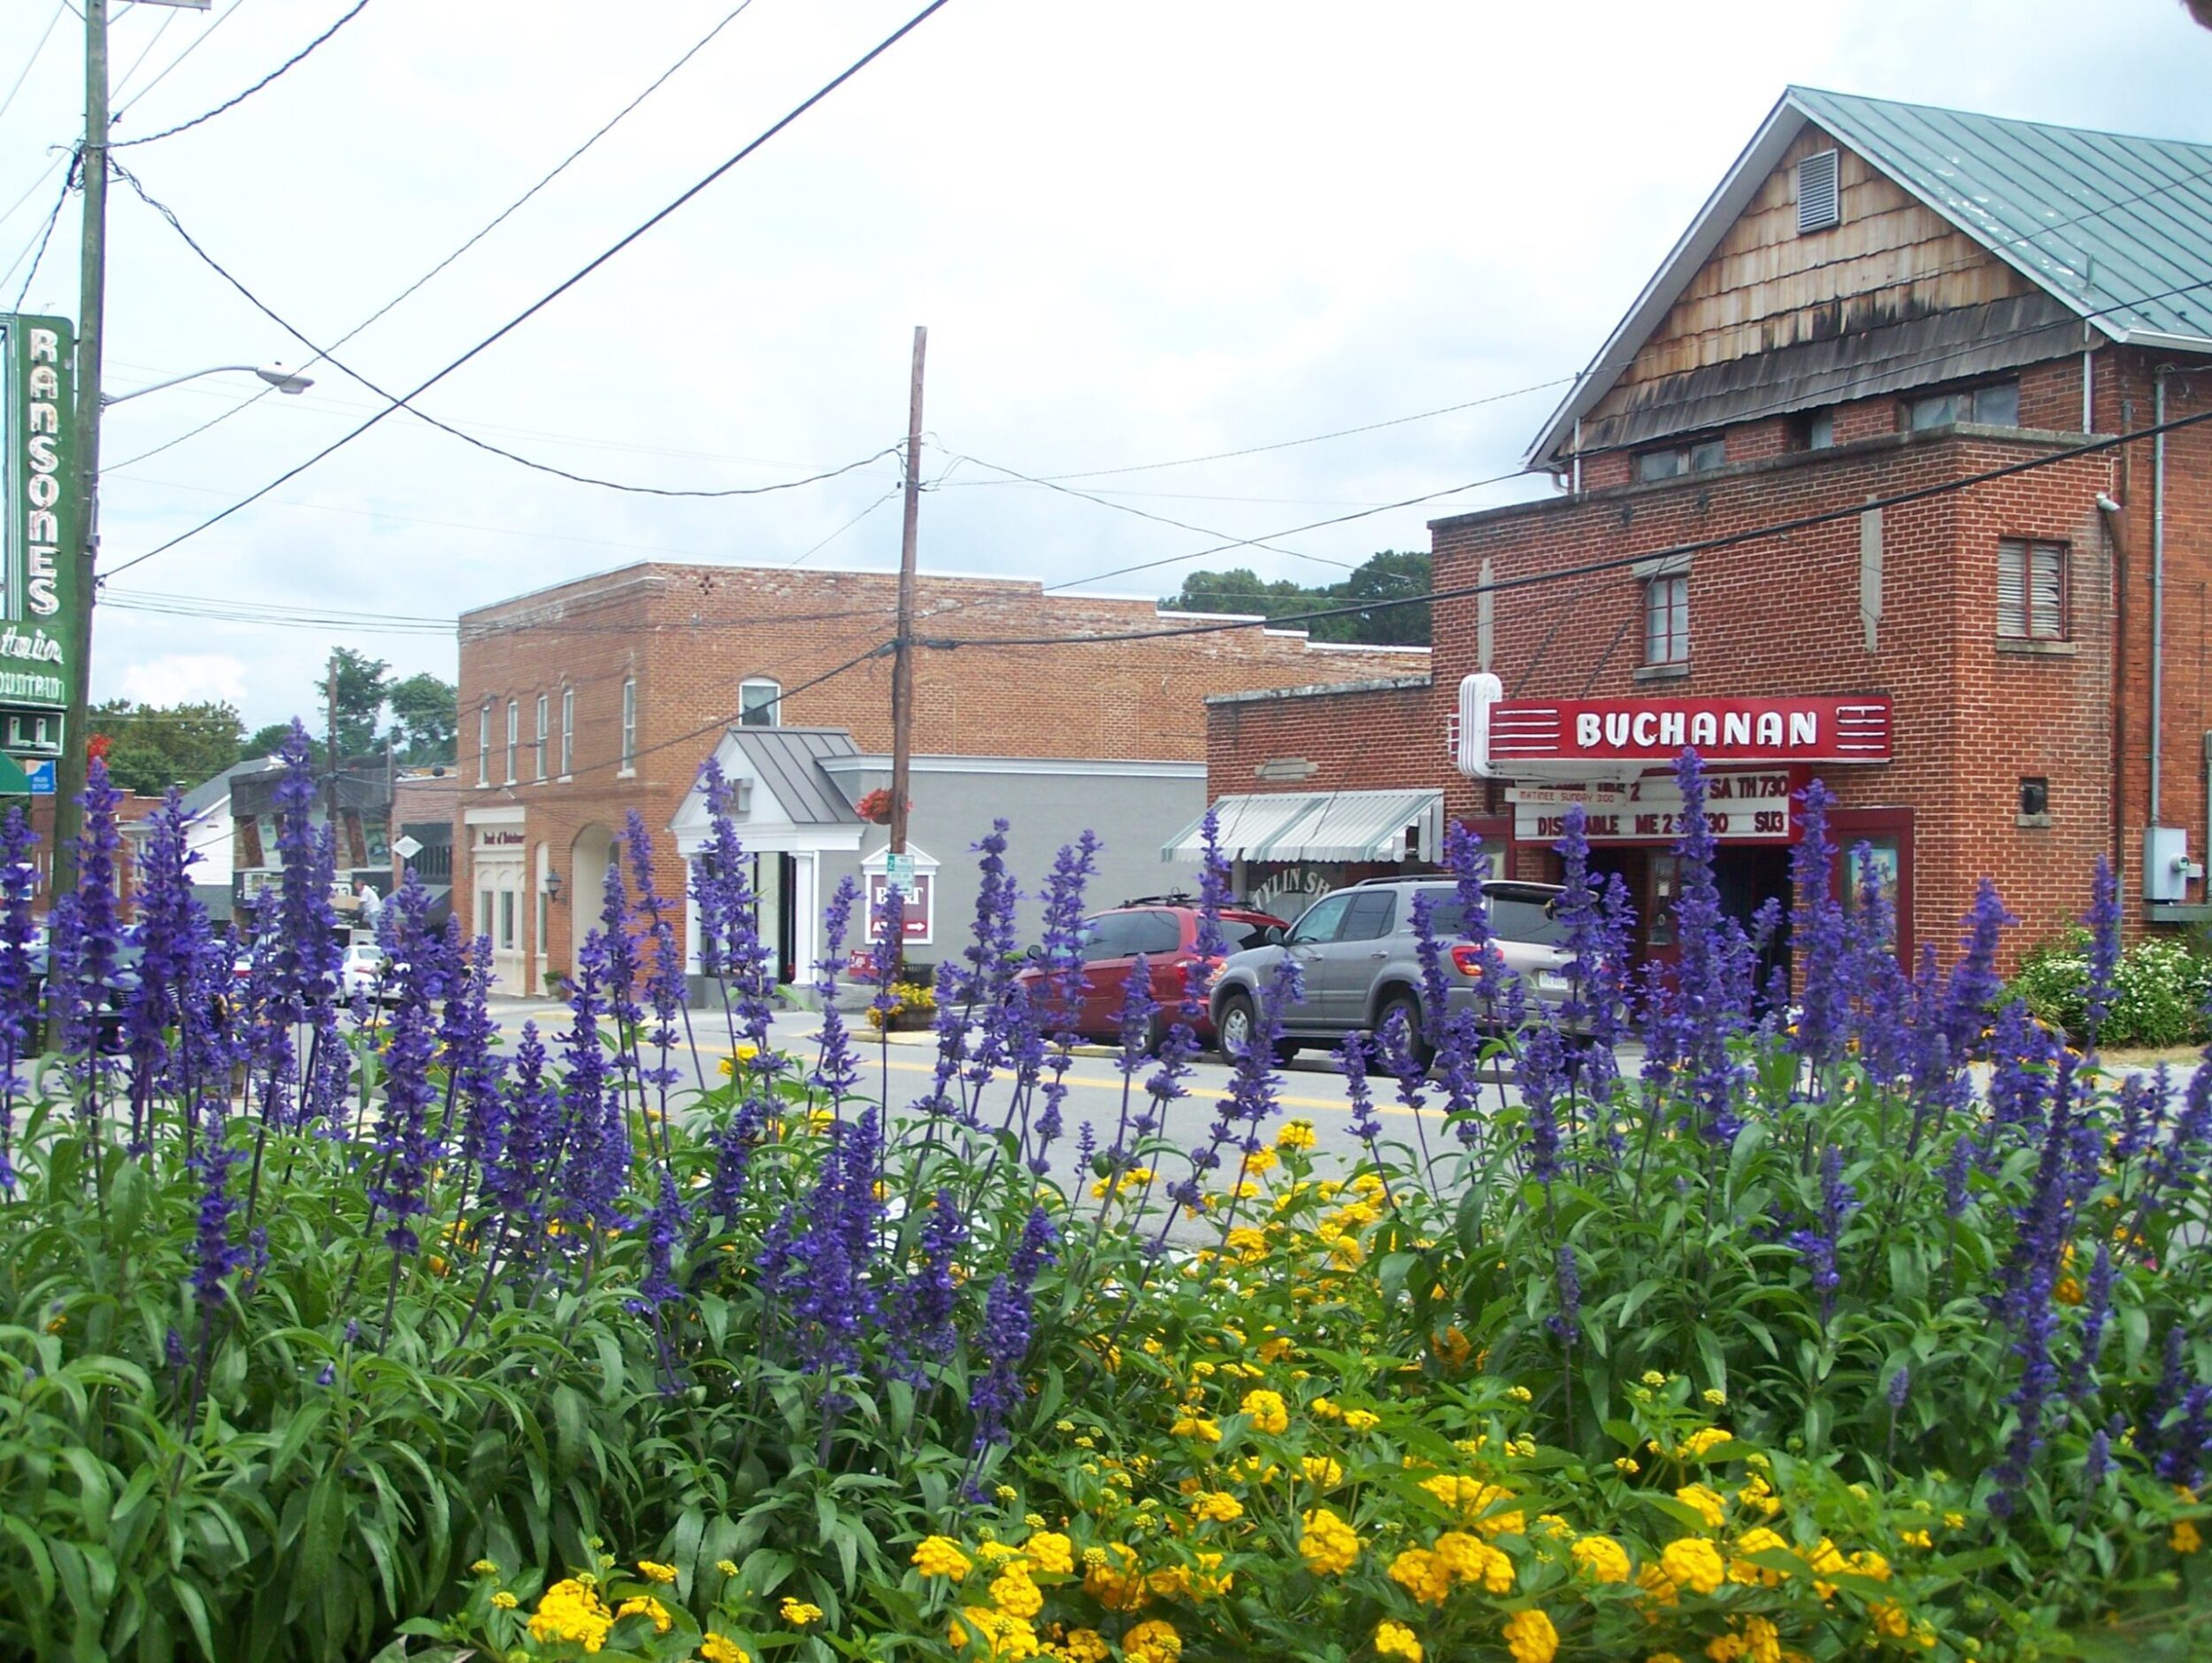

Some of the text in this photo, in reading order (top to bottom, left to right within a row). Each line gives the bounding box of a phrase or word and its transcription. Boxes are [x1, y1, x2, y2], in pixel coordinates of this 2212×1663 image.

[1576, 712, 1817, 748] BUCHANAN
[1519, 790, 1555, 801] MATINEE
[1560, 792, 1593, 803] SUNDAY
[1758, 775, 1789, 797] 730
[1635, 814, 1659, 835] ME
[1663, 813, 1673, 834] 2
